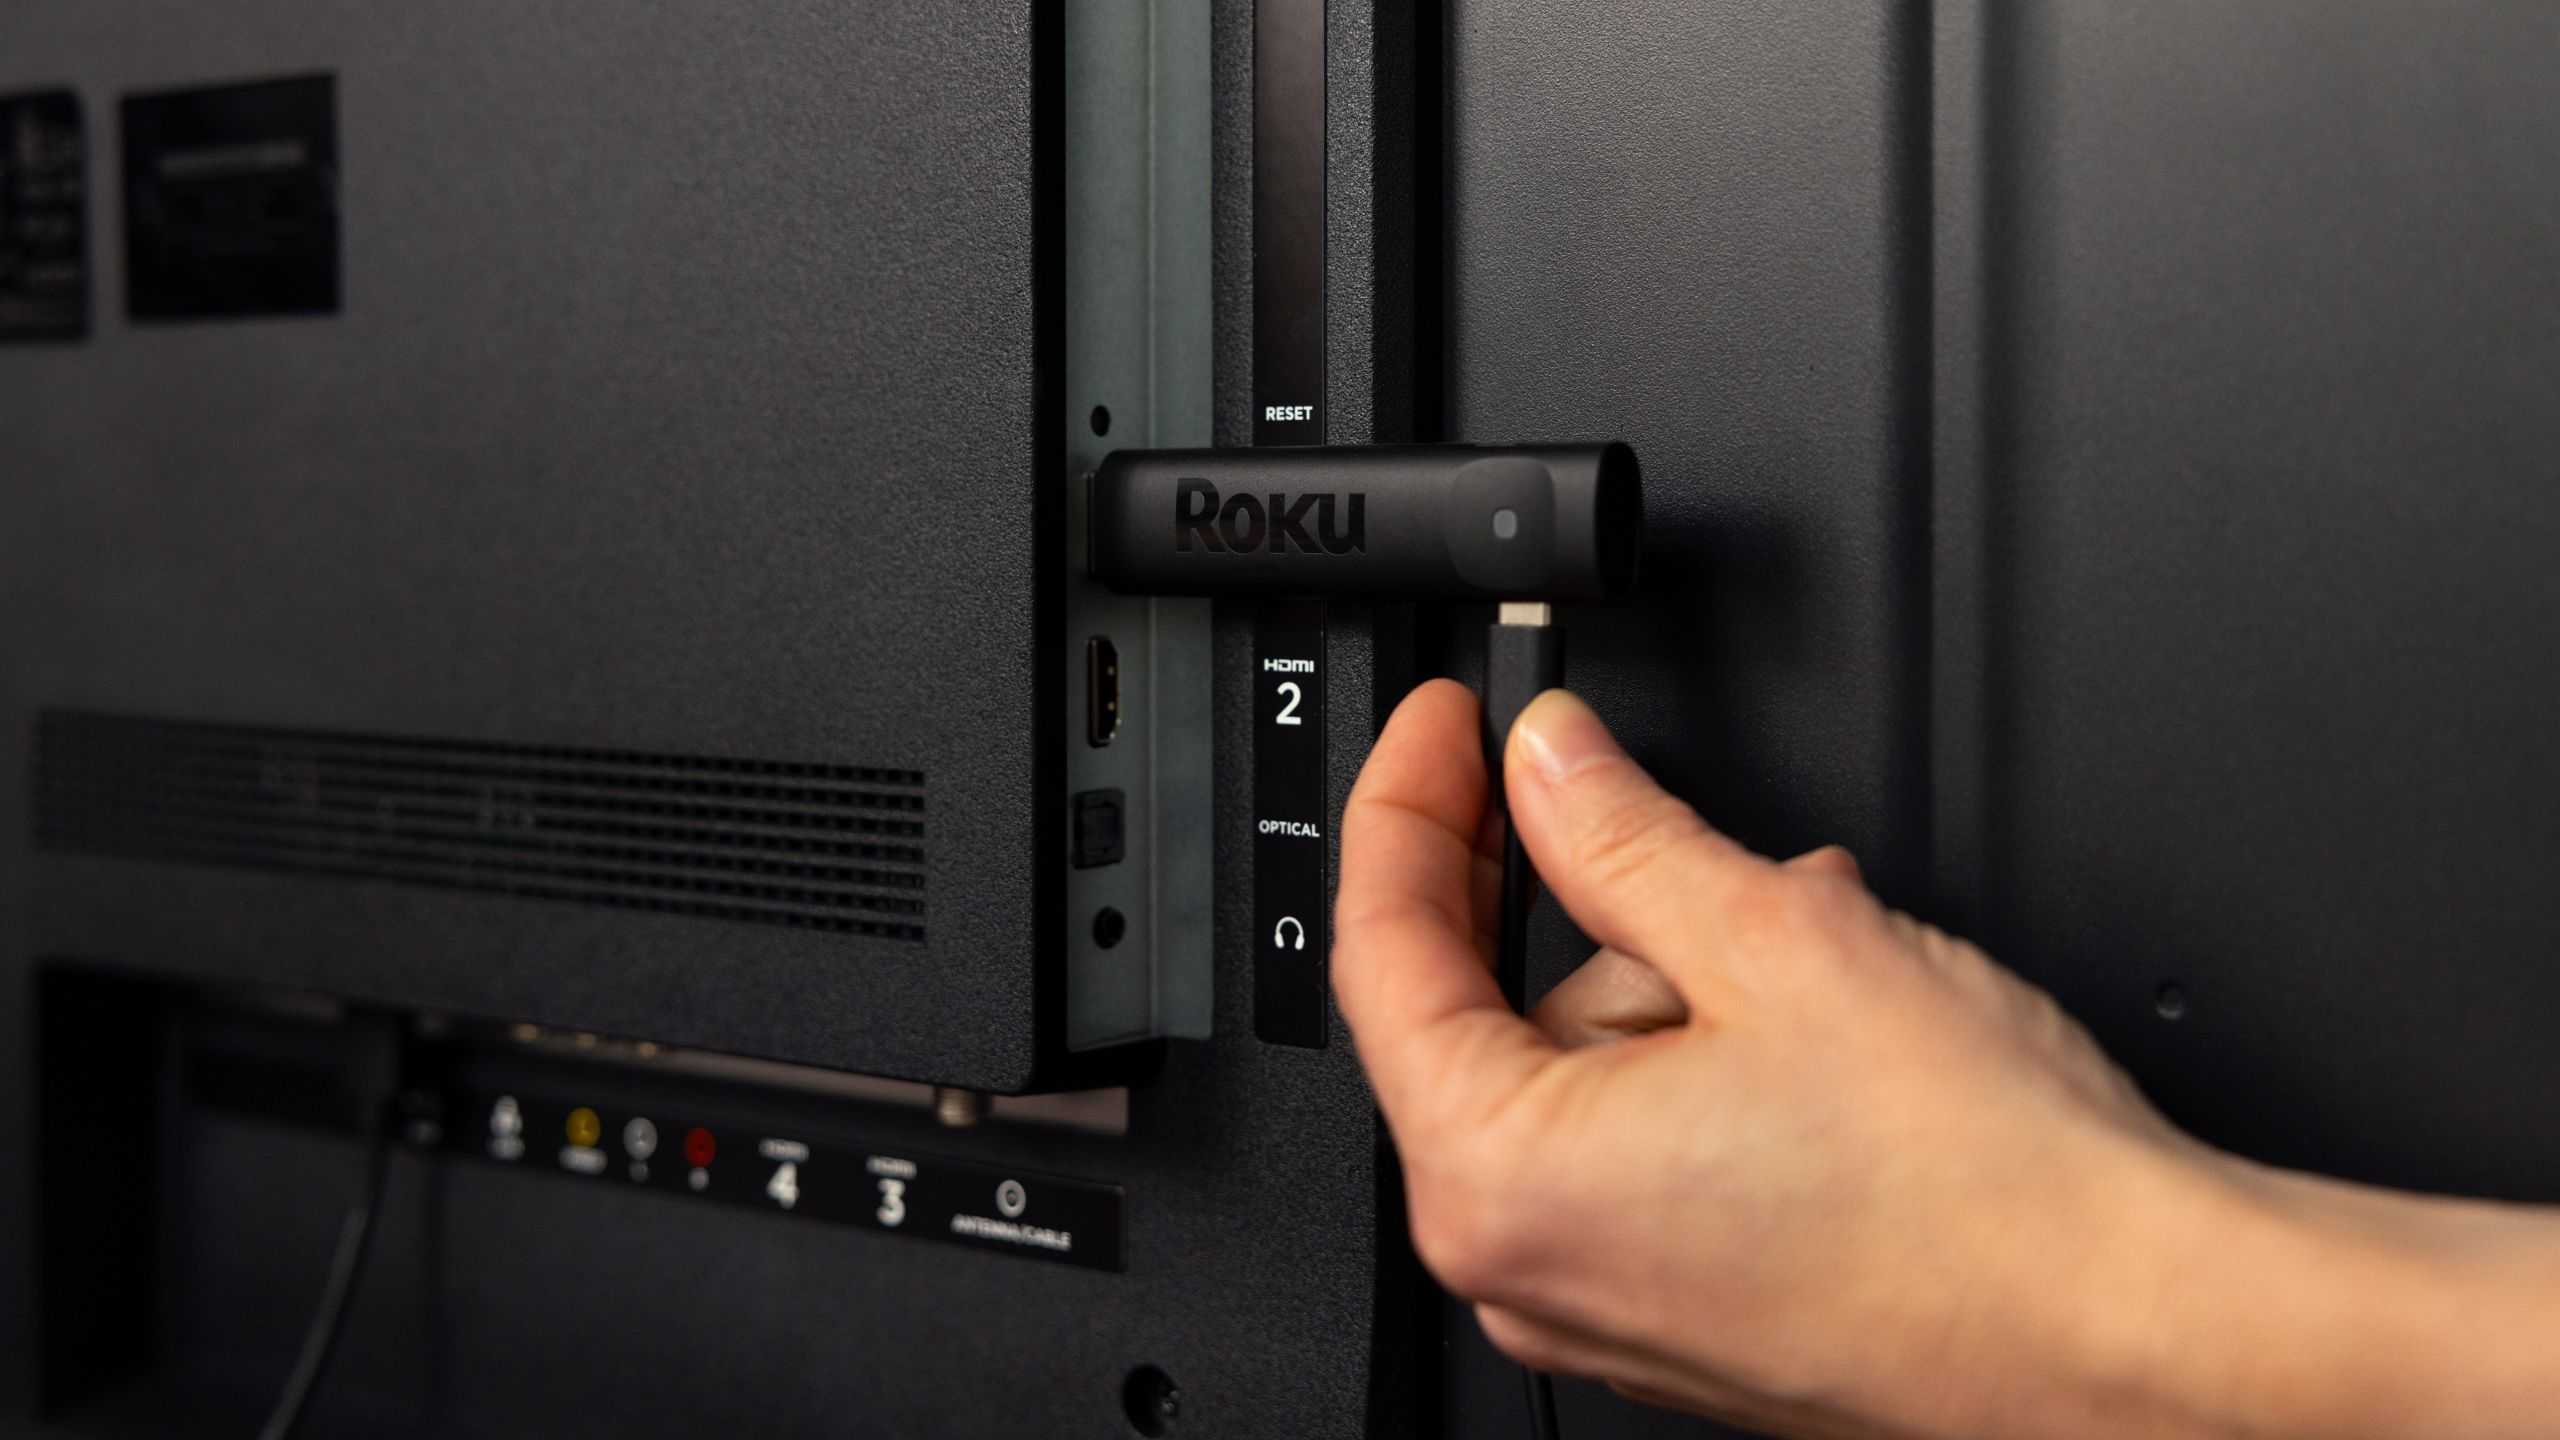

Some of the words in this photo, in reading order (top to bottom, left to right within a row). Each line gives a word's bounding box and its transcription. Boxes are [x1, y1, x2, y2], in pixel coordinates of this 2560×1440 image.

[1265, 405, 1314, 421] RESET
[1263, 658, 1315, 673] HDMI
[1275, 681, 1302, 726] 2
[1258, 819, 1321, 838] OPTICAL
[766, 1160, 800, 1210] 4
[876, 1177, 907, 1228] 3
